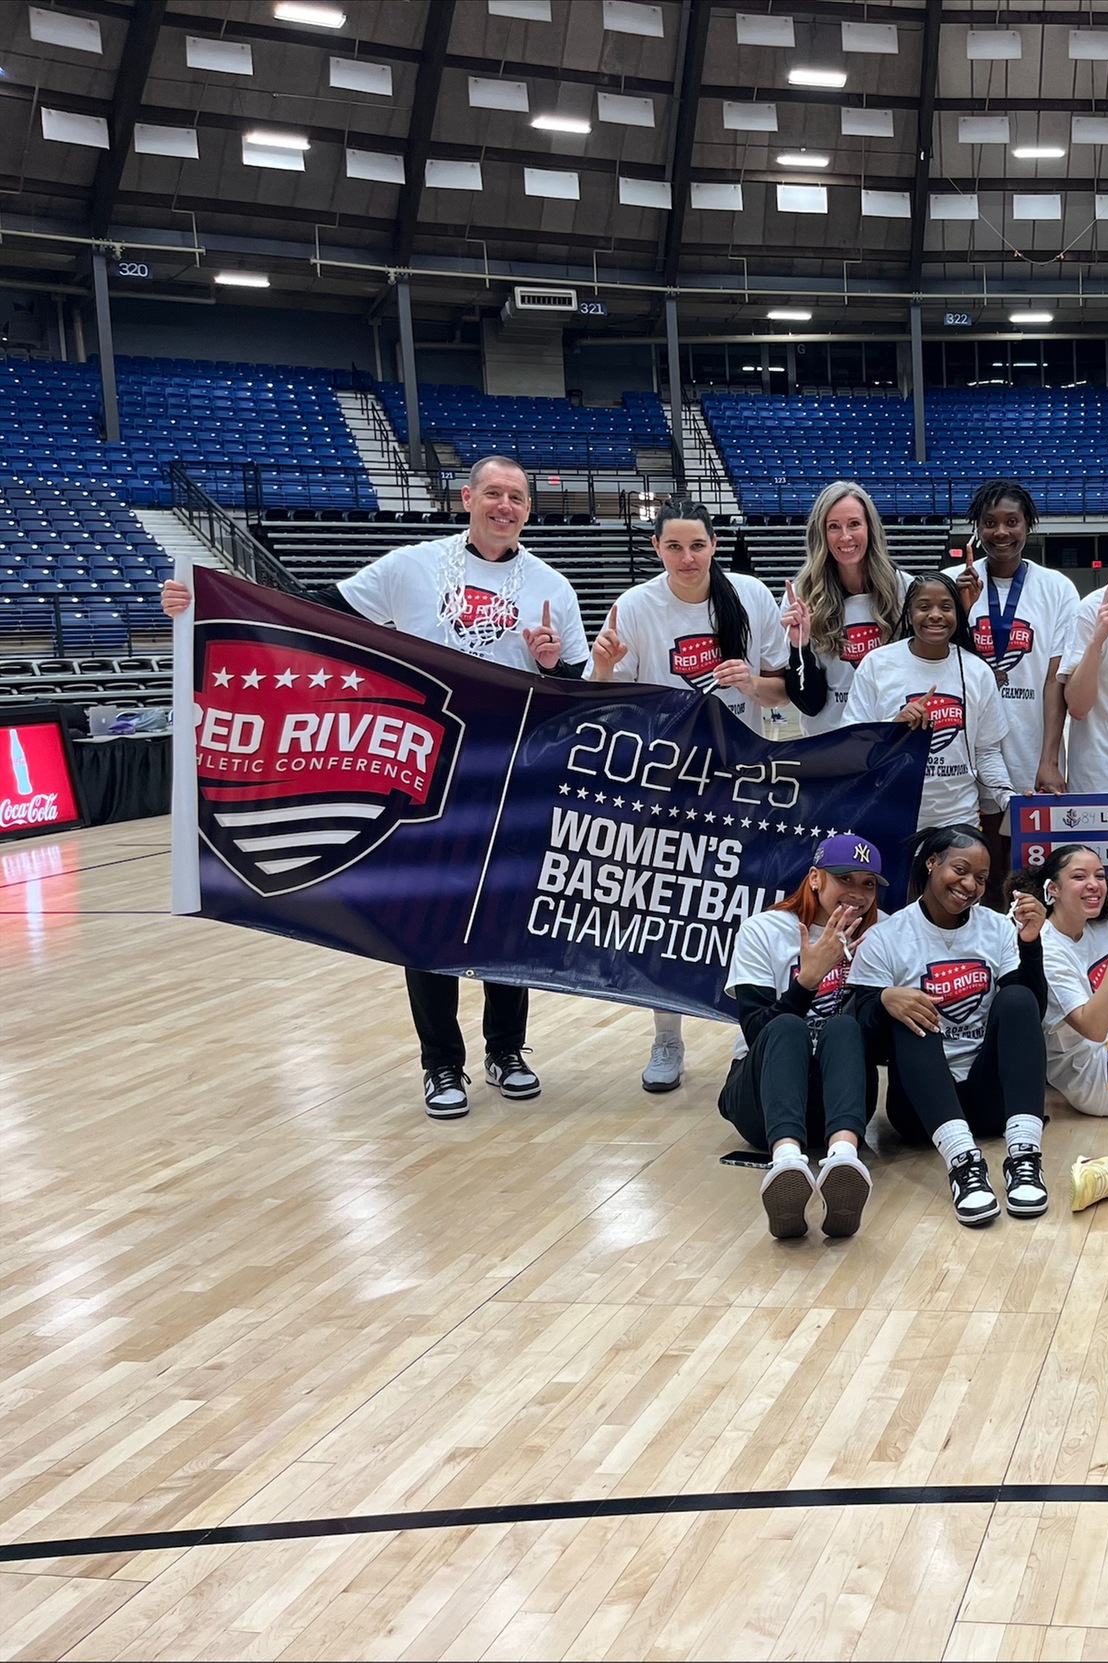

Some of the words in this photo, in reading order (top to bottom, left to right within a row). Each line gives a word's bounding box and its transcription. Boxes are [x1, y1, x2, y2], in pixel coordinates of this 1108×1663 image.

[118, 262, 149, 277] 320
[580, 302, 605, 315] 321
[945, 313, 969, 325] 322
[796, 343, 806, 355] G
[440, 471, 454, 479] 121
[1009, 630, 1030, 643] VER
[674, 655, 697, 667] RED
[700, 647, 723, 663] RIV
[843, 642, 865, 654] RED
[930, 707, 963, 720] RIVER
[278, 711, 435, 774] RIVER
[566, 722, 802, 809] 2024-25
[927, 757, 945, 765] 025
[196, 753, 264, 773] HLETIC
[275, 756, 425, 792] CONFERENCE
[0, 792, 59, 828] Coca-Cola
[1029, 809, 1041, 831] 1
[550, 806, 743, 879] WOMEN'S
[853, 843, 870, 863] NY
[1027, 845, 1046, 866] 8
[537, 851, 786, 923] BASKETBAL
[527, 895, 736, 968] CHAMPION
[925, 981, 951, 994] RED
[953, 971, 988, 990] RIVER
